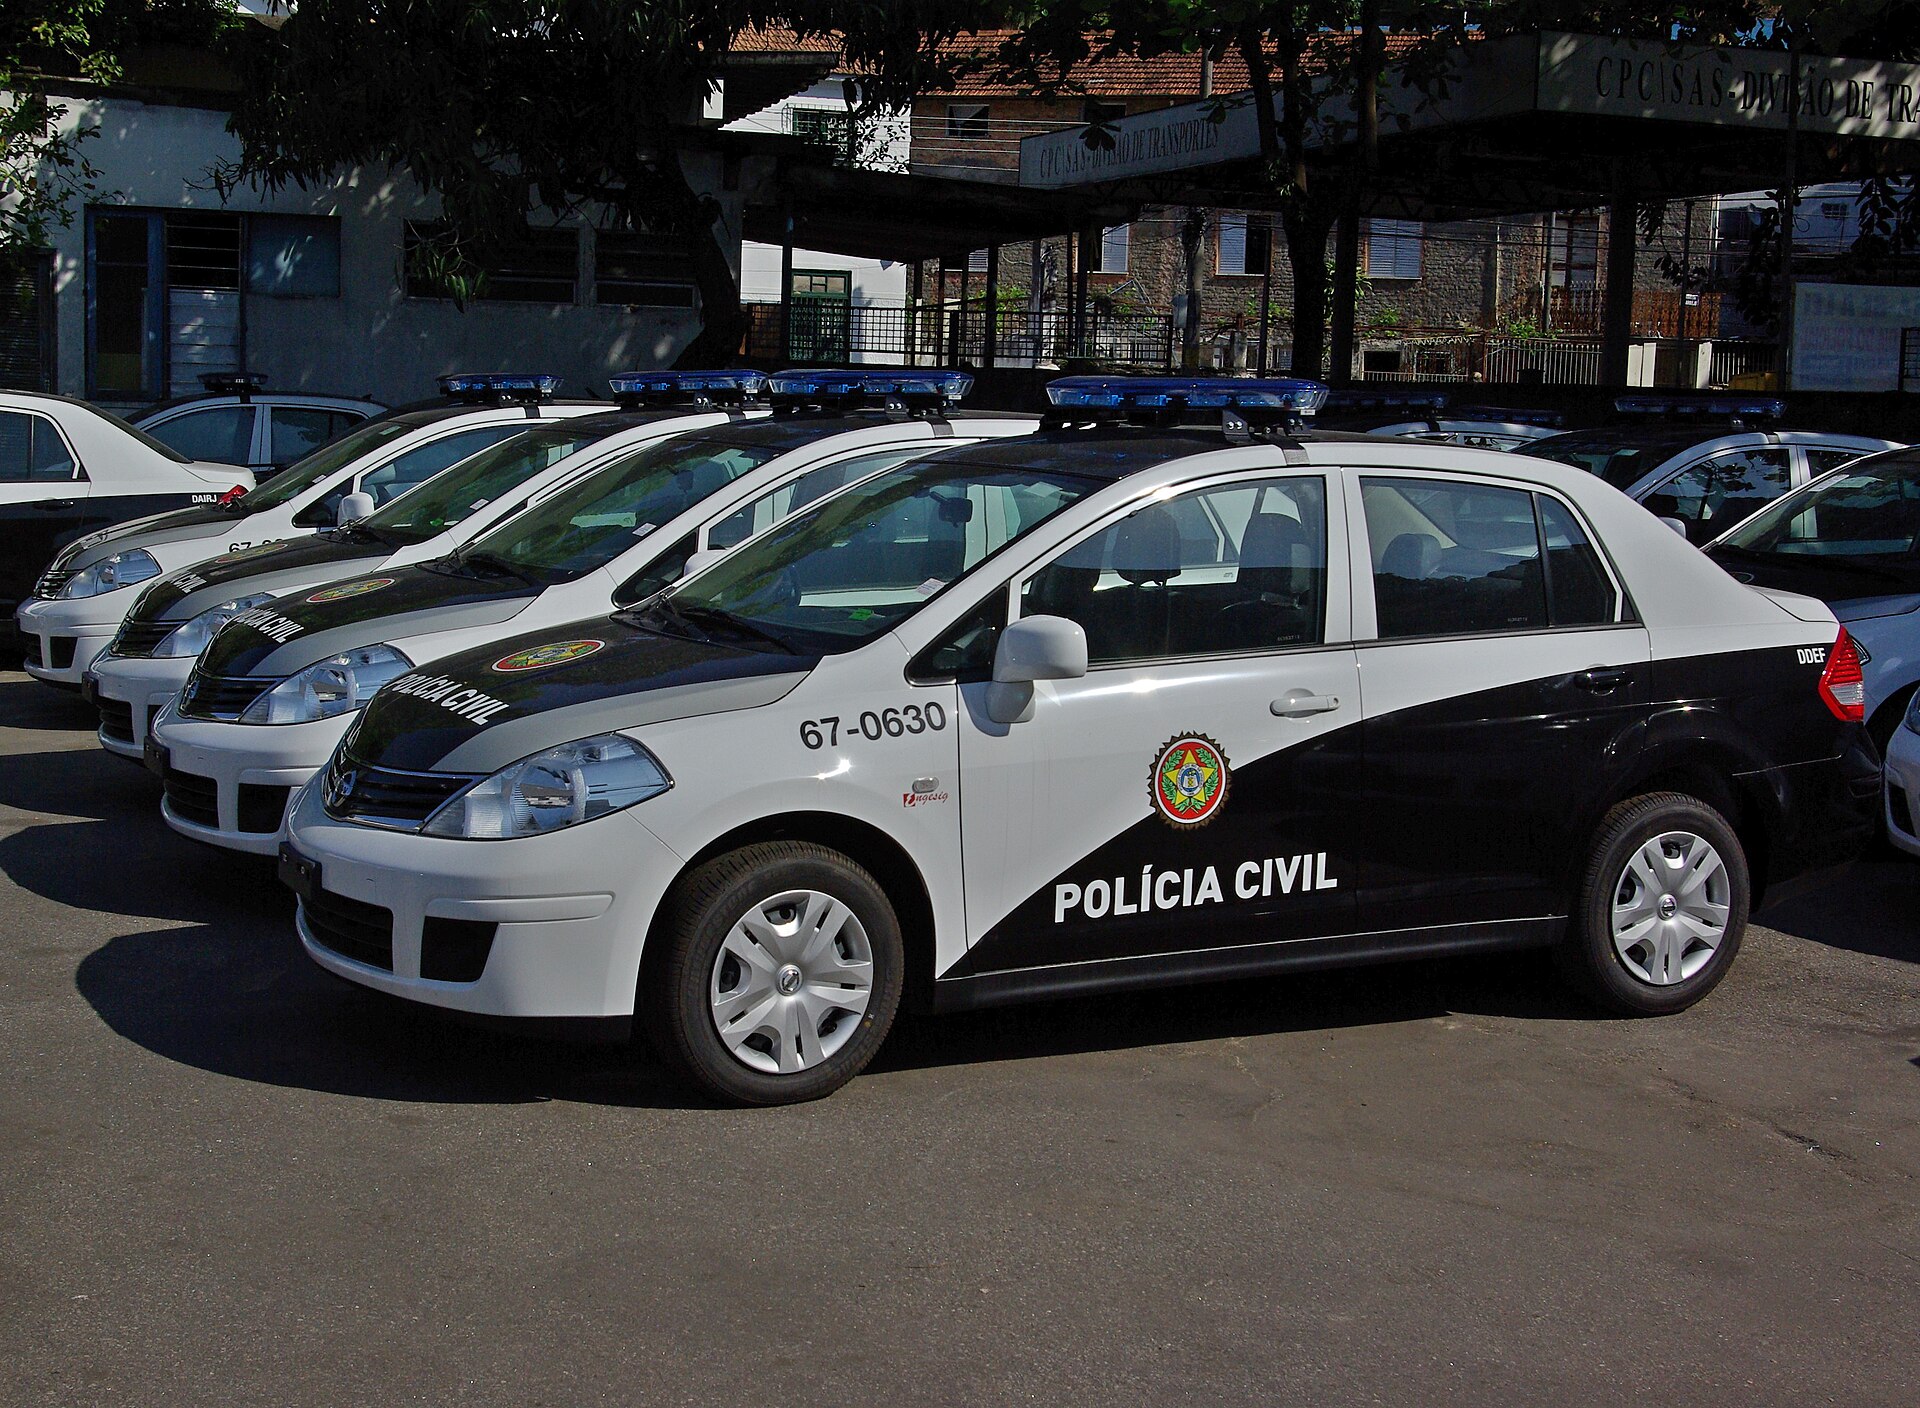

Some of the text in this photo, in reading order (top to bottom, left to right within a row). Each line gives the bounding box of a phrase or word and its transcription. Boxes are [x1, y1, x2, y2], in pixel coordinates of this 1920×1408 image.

[1845, 78, 1874, 121] DE
[1132, 129, 1146, 161] DE
[1148, 117, 1218, 158] TRANSPORTES
[191, 494, 218, 504] DAIRJ
[258, 616, 305, 644] CIVIL
[1796, 647, 1826, 665] DDEF
[440, 688, 510, 726] CIVIL
[800, 701, 947, 750] 67-0630
[1054, 852, 1338, 923] POLÍCIA CIVIL
